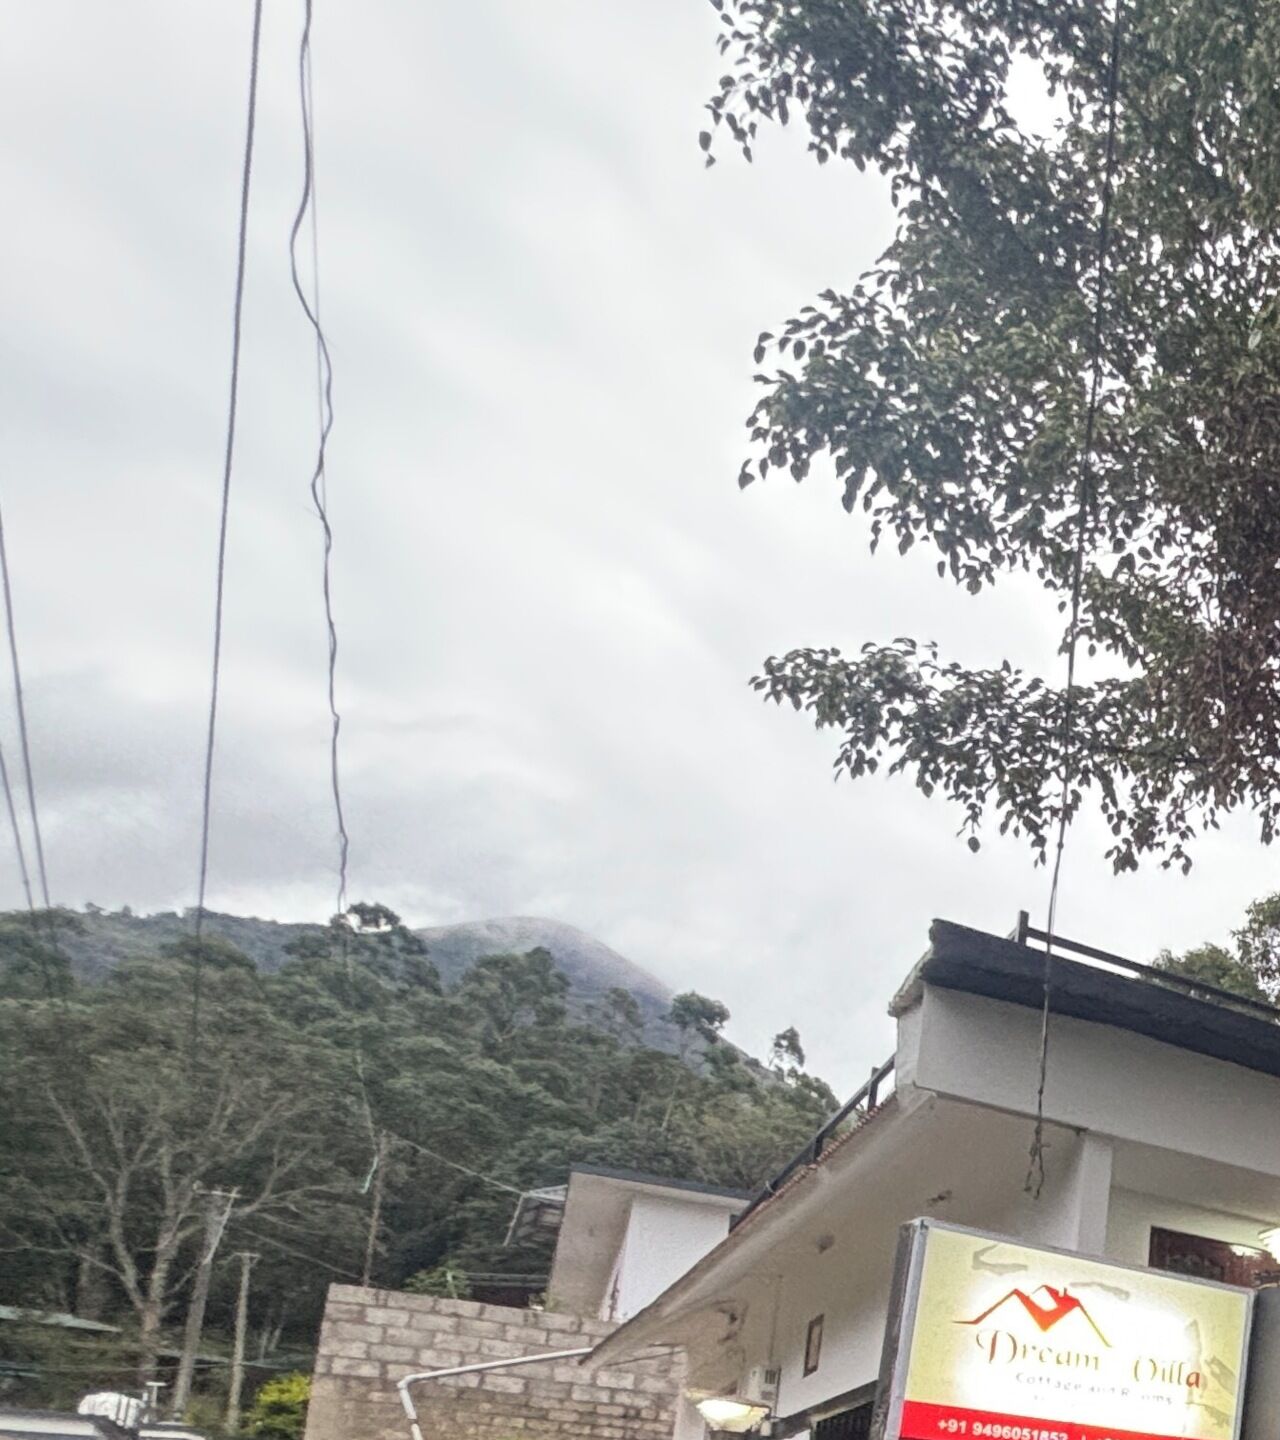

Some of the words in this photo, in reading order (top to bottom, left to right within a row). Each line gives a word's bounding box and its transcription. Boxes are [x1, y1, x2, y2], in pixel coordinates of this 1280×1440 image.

[975, 1329, 1099, 1371] Dream
[1121, 1386, 1173, 1406] Roms
[937, 1418, 967, 1435] +91
